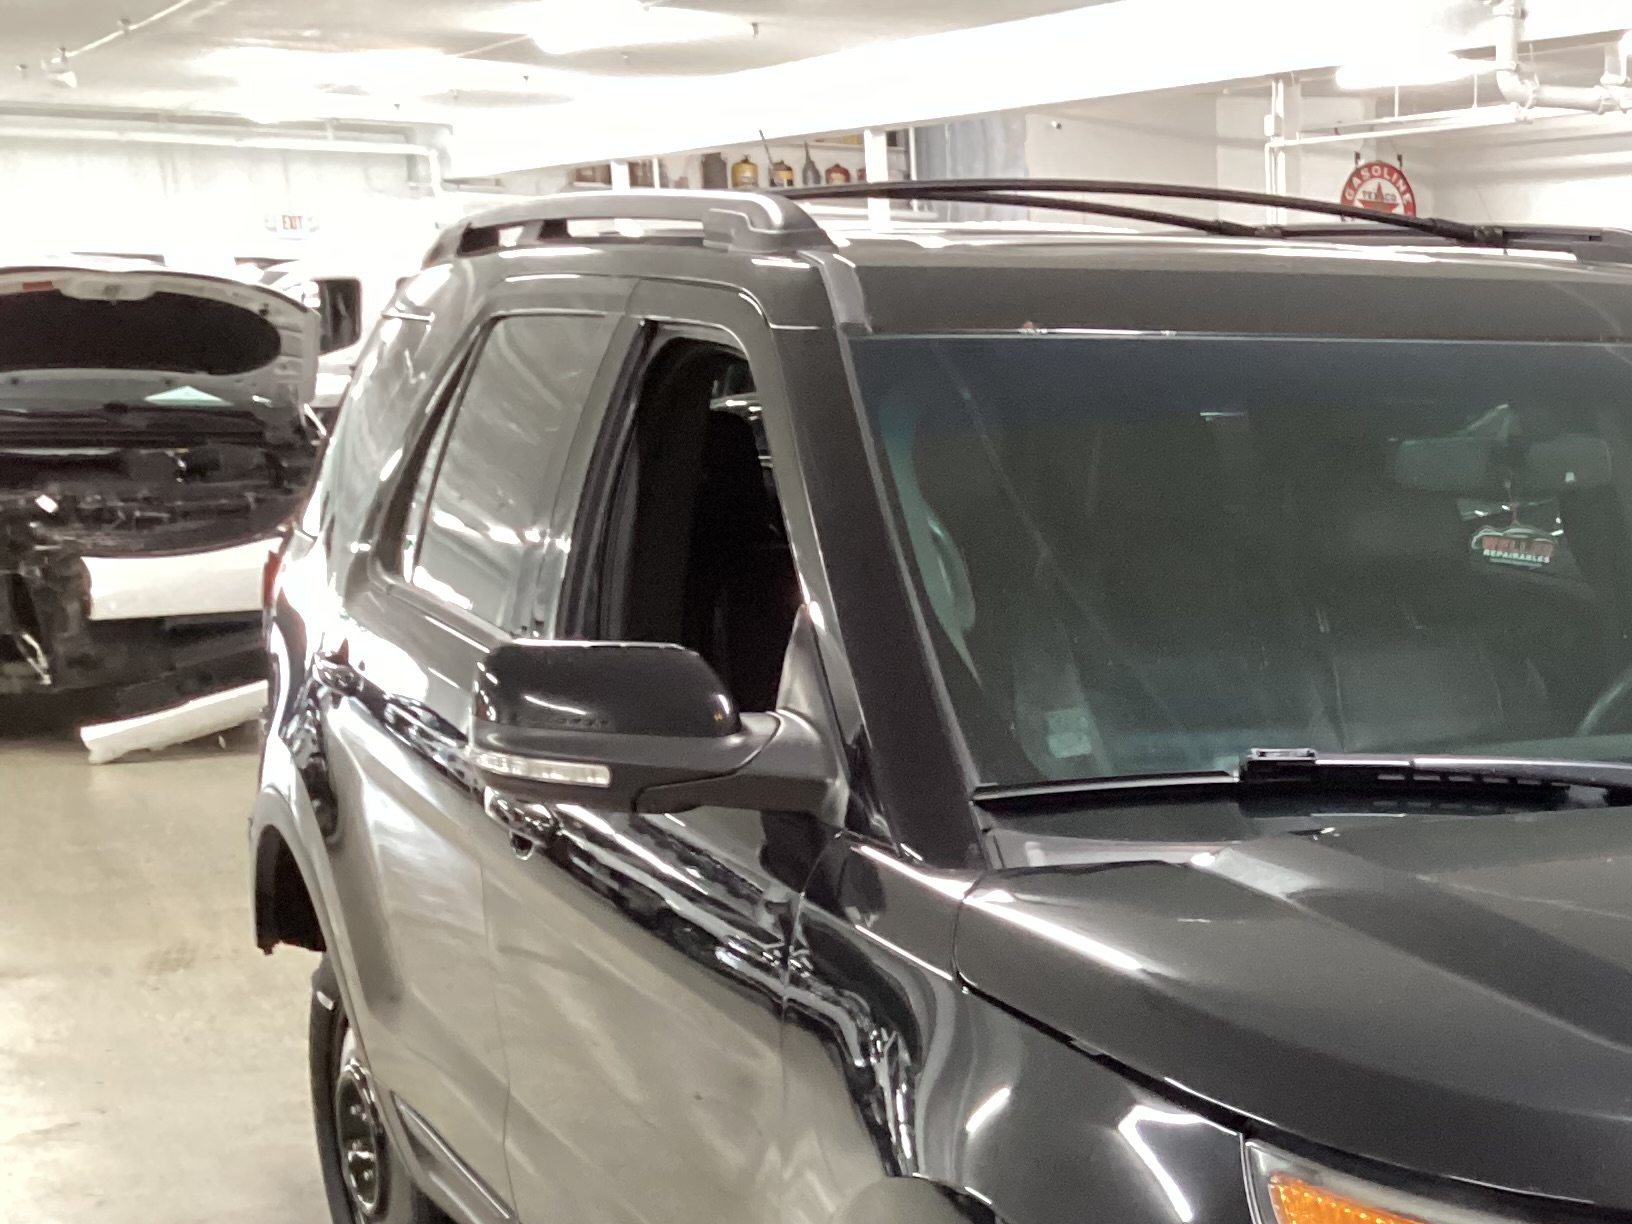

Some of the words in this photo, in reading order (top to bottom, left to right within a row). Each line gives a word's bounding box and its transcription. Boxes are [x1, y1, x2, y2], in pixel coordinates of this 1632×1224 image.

[1344, 165, 1412, 204] GASOLINE
[1361, 190, 1397, 202] TECO
[1483, 549, 1550, 563] REPAIRABLES
